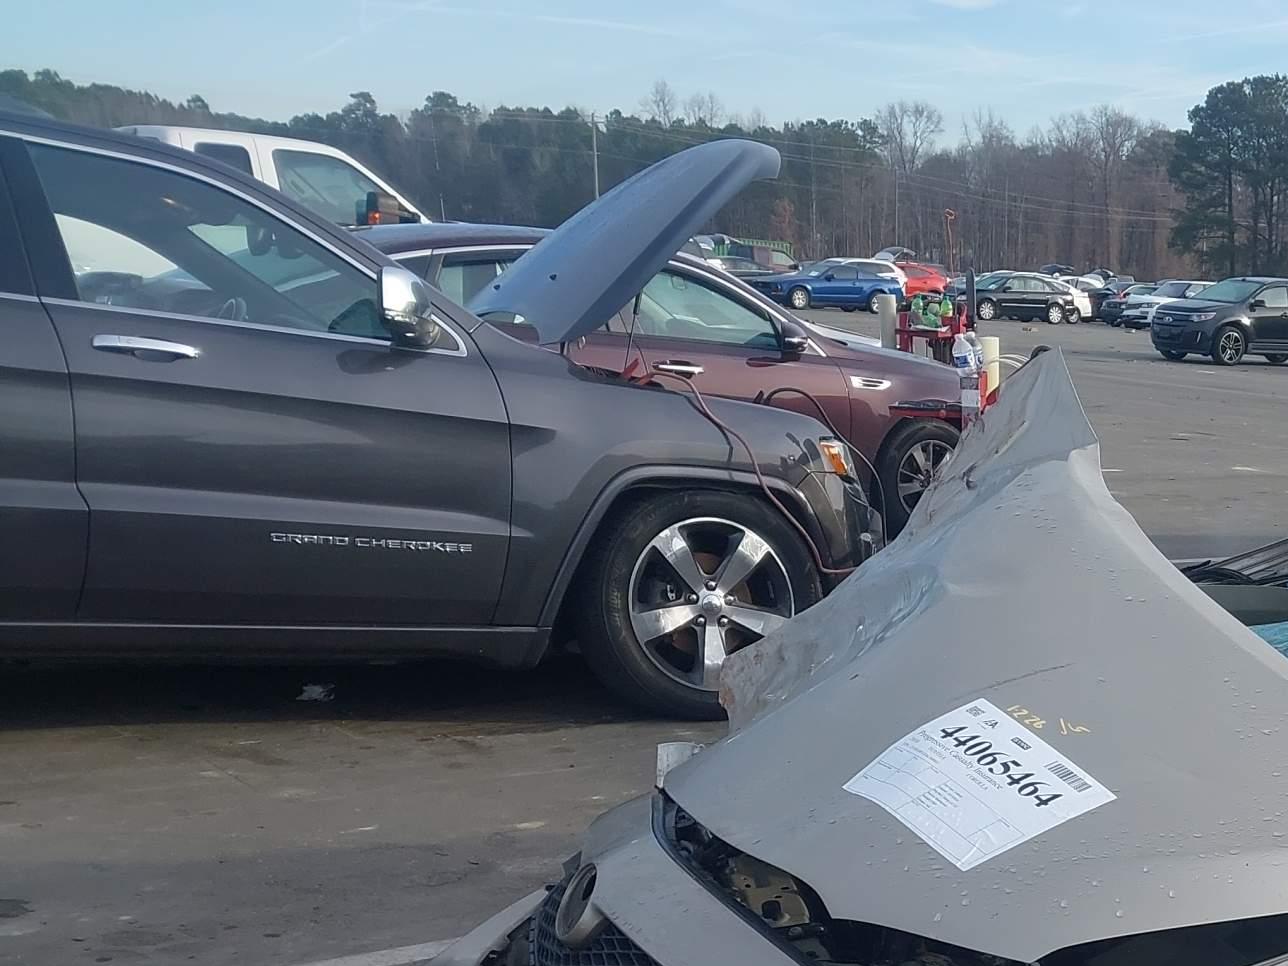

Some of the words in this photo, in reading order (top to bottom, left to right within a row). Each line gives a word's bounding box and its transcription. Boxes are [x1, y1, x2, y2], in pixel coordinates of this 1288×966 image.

[269, 531, 349, 546] GRAND
[354, 536, 473, 553] CHEROKEE
[939, 725, 1064, 808] 44065464
[974, 766, 1004, 790] Insurance
